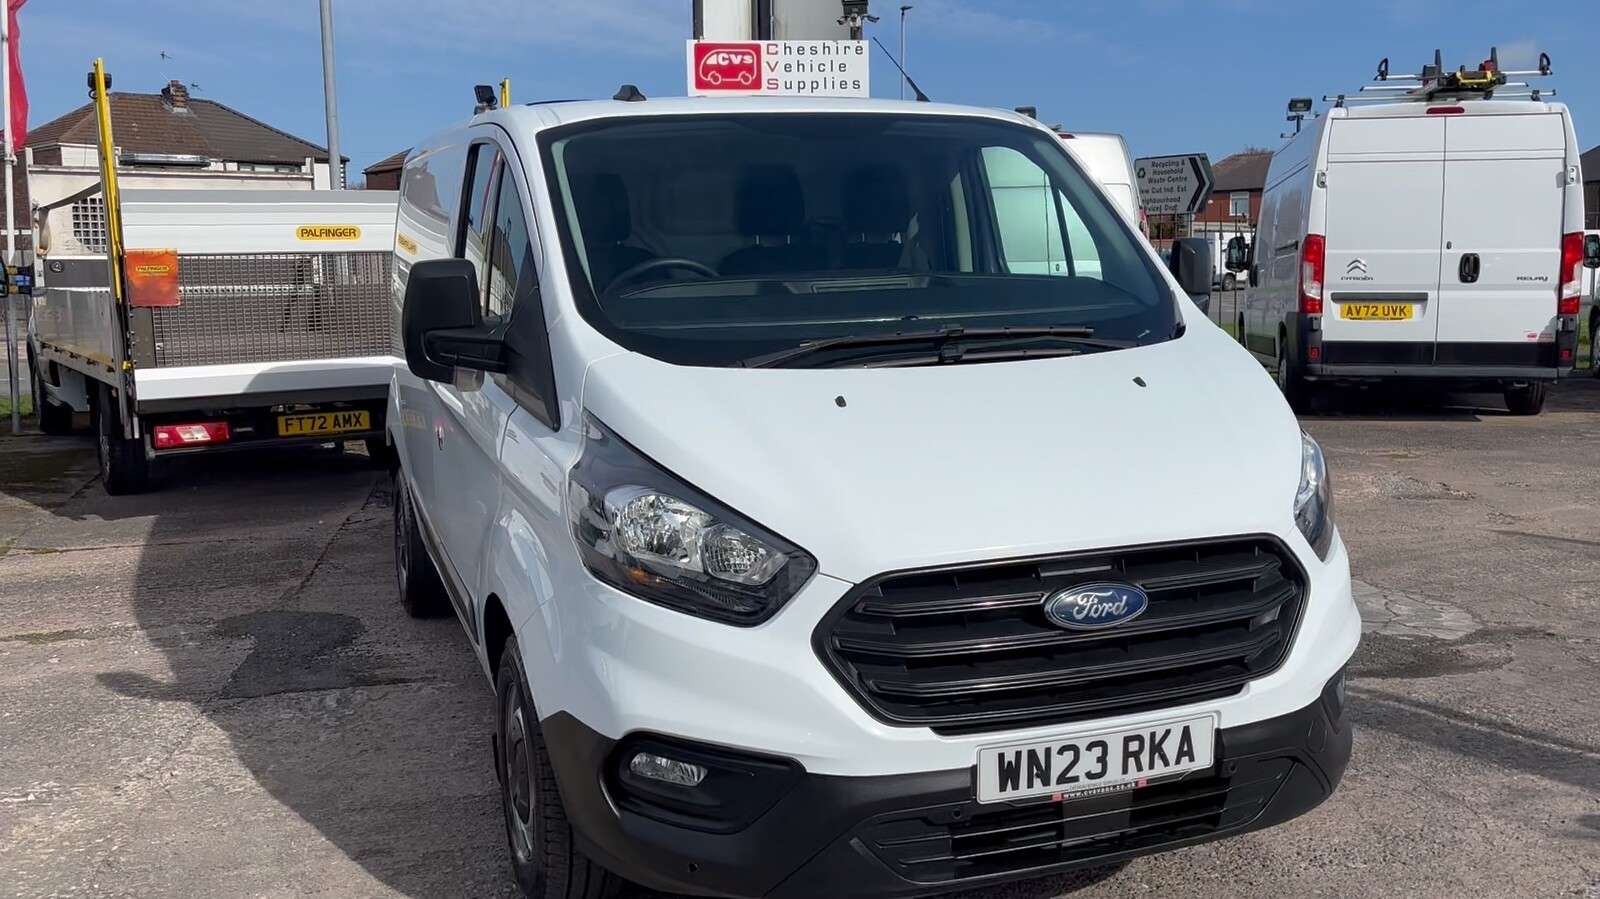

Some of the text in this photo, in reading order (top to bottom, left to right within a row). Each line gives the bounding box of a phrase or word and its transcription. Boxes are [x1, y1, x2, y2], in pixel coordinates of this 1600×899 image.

[766, 42, 864, 56] Cheshire
[766, 60, 847, 73] Vehicle
[766, 77, 861, 93] Supplies
[1151, 160, 1180, 168] Recycling
[301, 228, 357, 238] PALFINGER
[1345, 304, 1407, 317] AV72 UVK
[284, 412, 363, 433] FT72 AMX
[1073, 591, 1128, 620] Ford
[997, 725, 1196, 793] WN23 RKA
